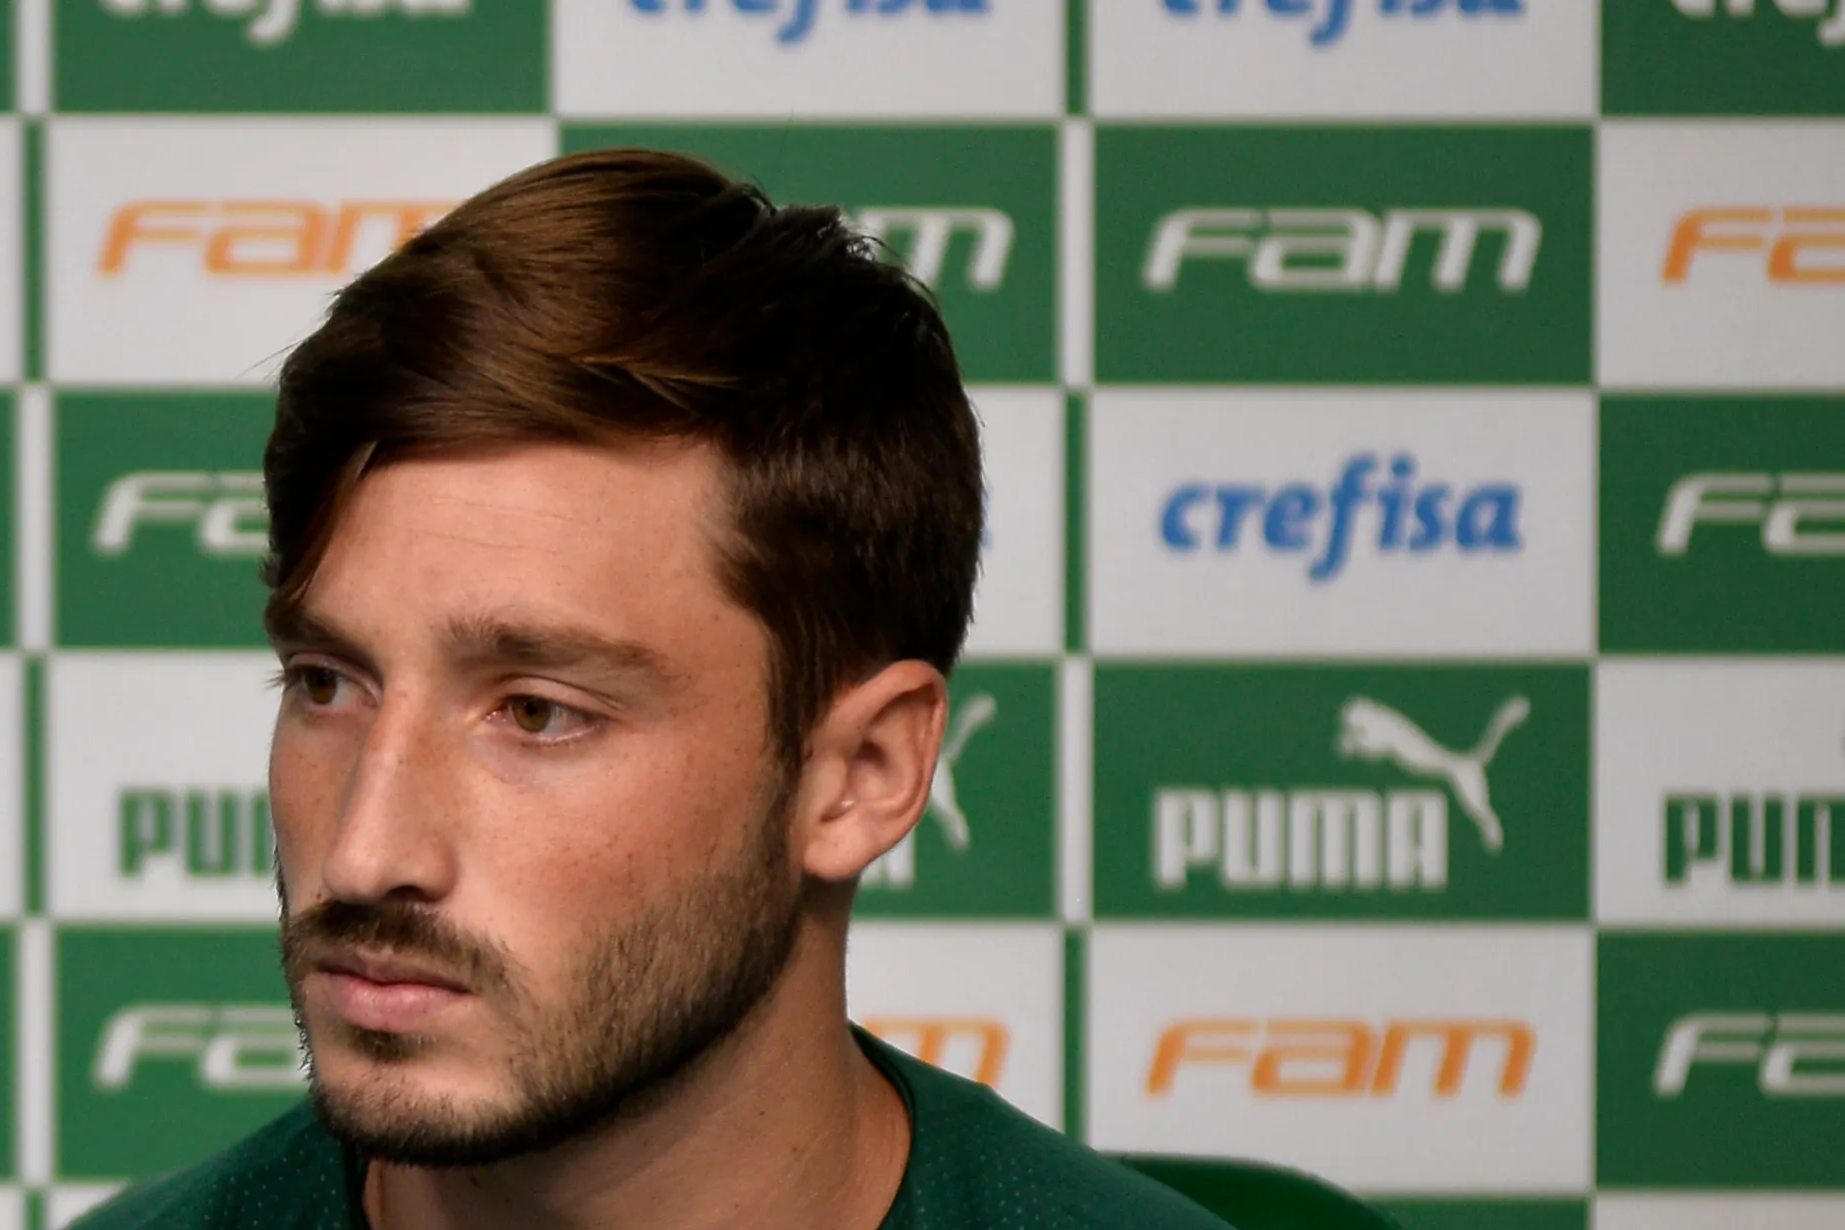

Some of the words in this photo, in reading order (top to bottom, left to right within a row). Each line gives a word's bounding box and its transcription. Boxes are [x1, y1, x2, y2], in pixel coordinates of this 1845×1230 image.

[1662, 207, 1845, 284] Fa
[93, 471, 267, 556] Fa
[1160, 454, 1521, 582] crefisa
[1658, 474, 1845, 554] Fa
[1154, 790, 1447, 887] PUMA
[93, 1005, 307, 1090] Fa
[1655, 1015, 1845, 1093] Fa
